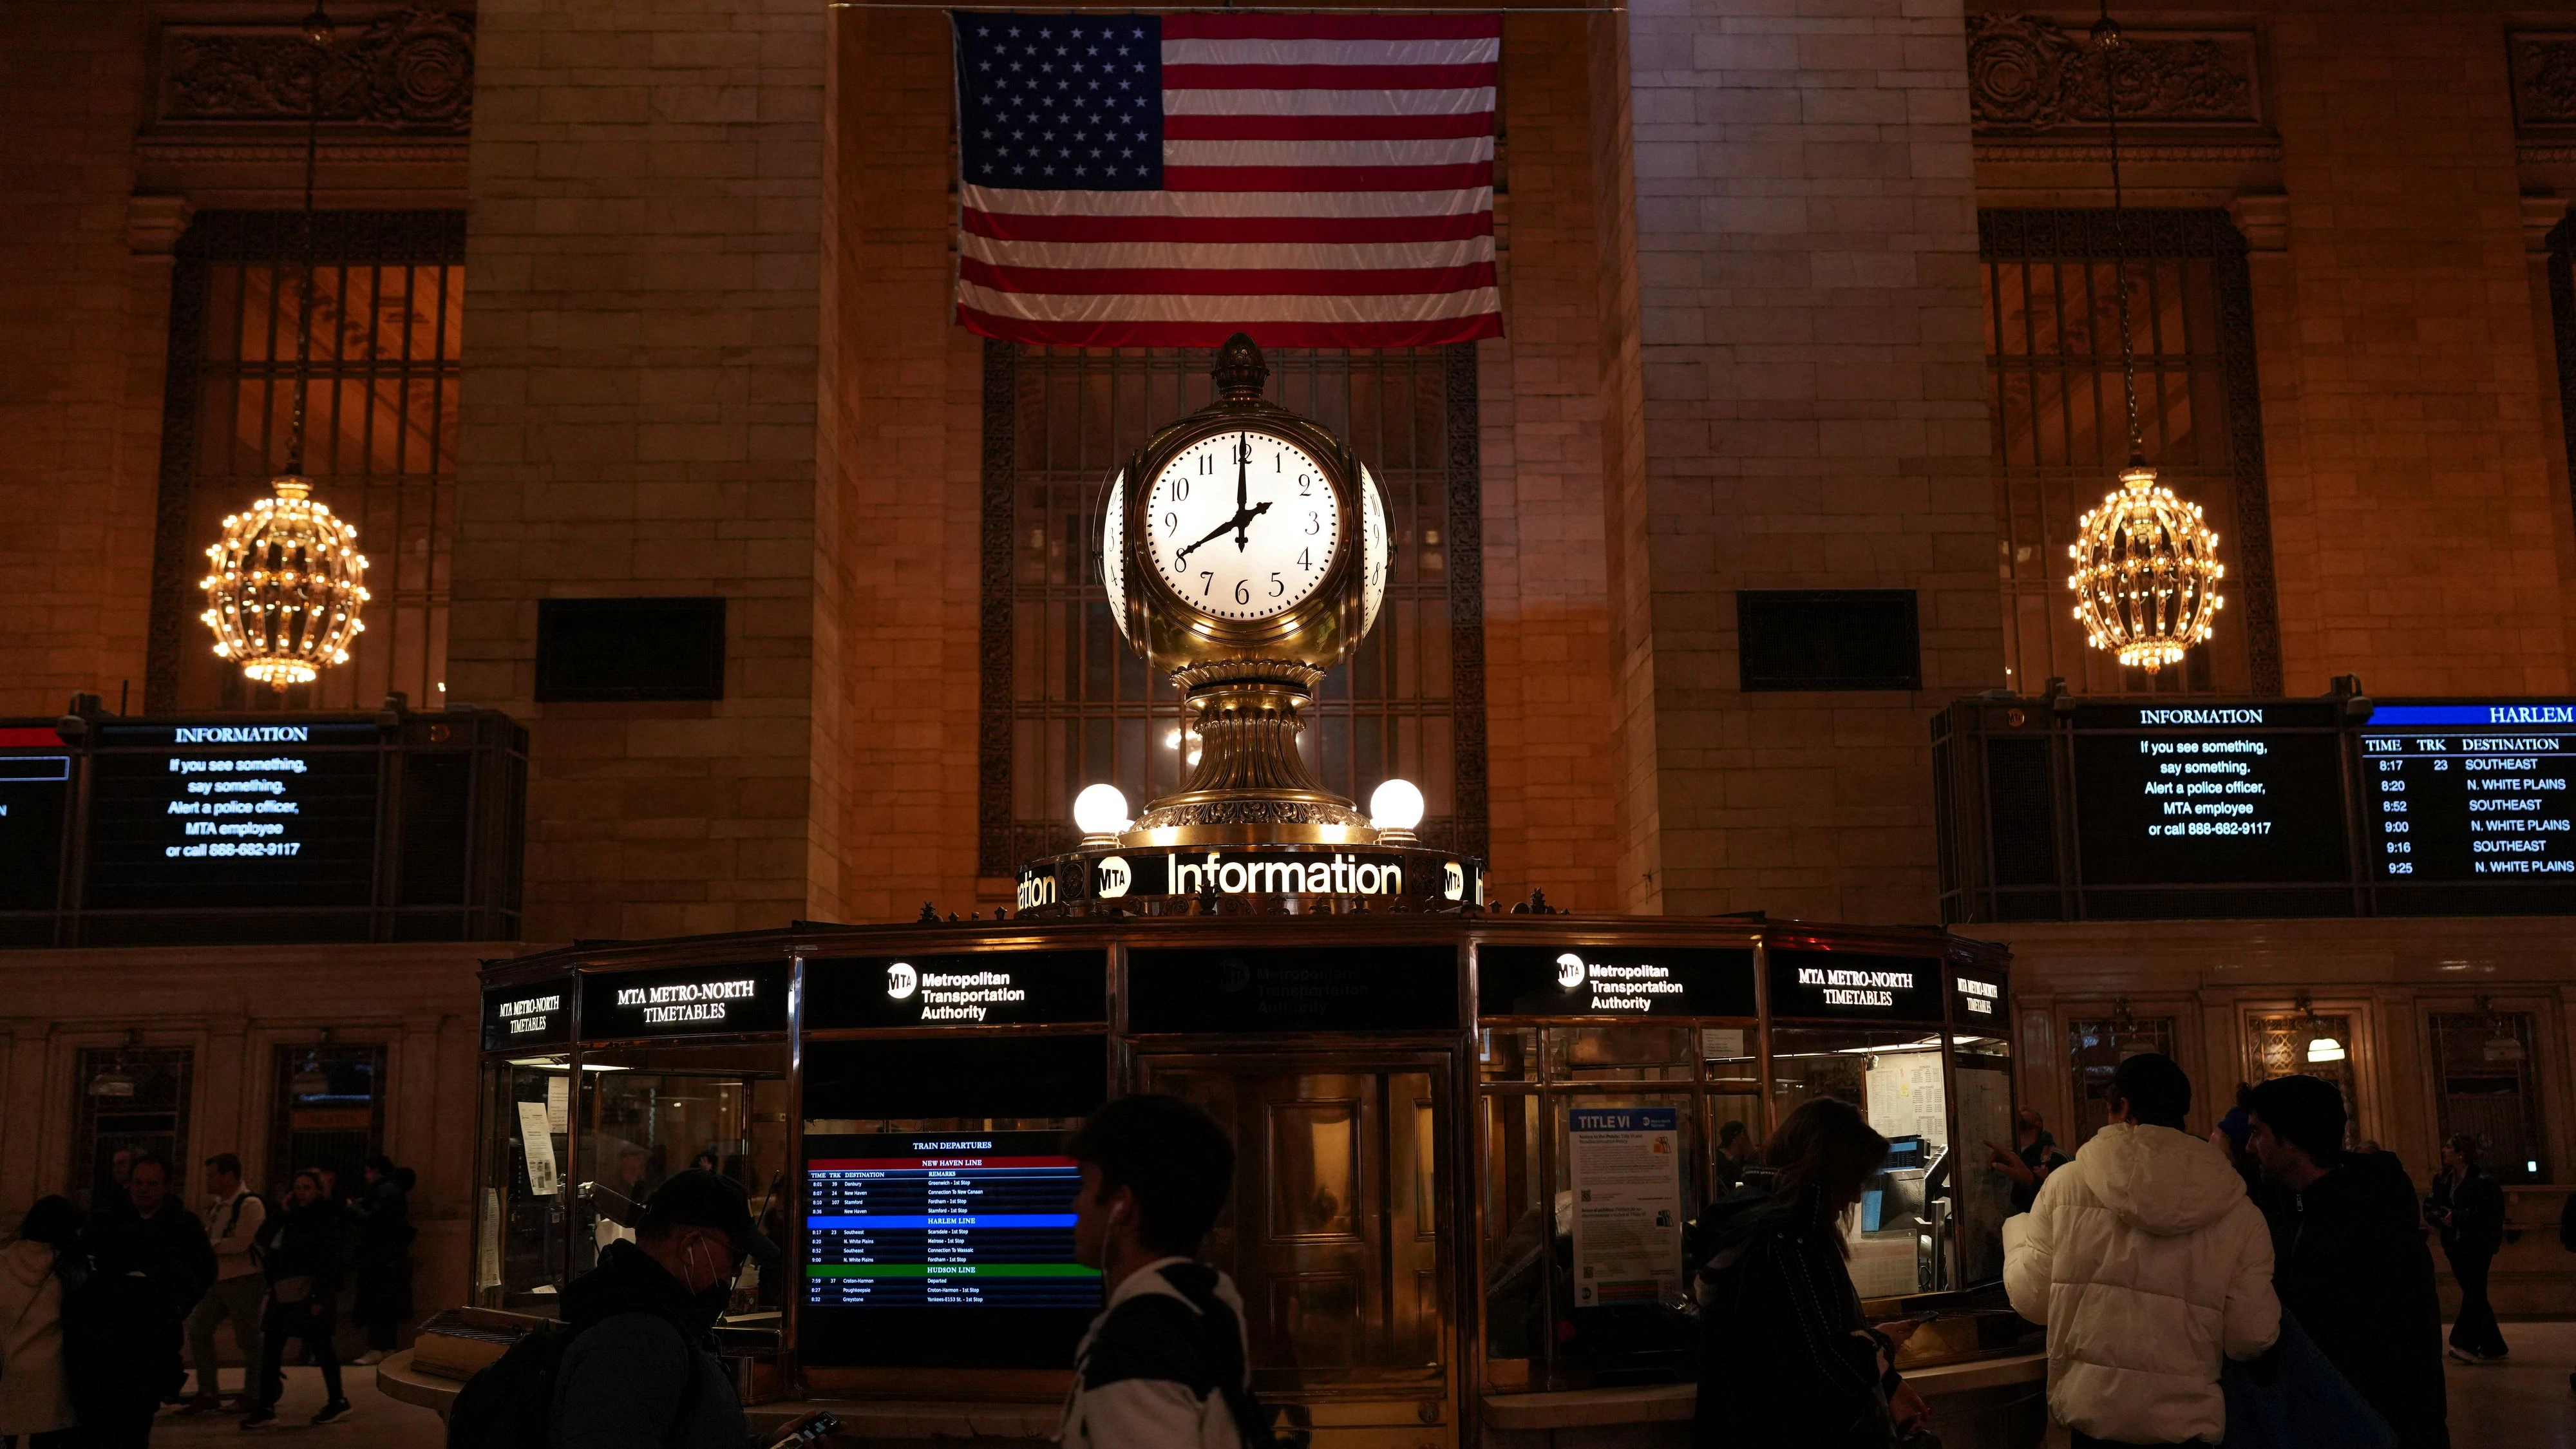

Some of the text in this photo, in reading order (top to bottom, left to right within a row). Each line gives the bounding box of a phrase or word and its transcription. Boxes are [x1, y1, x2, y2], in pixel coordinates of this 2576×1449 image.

[1232, 444, 1253, 465] 12
[1275, 452, 1282, 473] 1
[1198, 453, 1213, 476] 11
[1171, 477, 1189, 502] 10
[1298, 474, 1312, 497] 2
[1165, 512, 1178, 538] 9
[1304, 511, 1320, 535] 3
[1174, 547, 1188, 573] 8
[1297, 547, 1312, 571] 4
[1200, 571, 1214, 596] 7
[1268, 572, 1284, 598] 5
[1235, 580, 1249, 605] 6
[2141, 710, 2262, 724] INFORMATION
[2490, 707, 2573, 723] HARLEM
[176, 727, 307, 743] INFORMATION
[2141, 740, 2267, 755] If you see something,
[2365, 739, 2559, 751] TIME TRK DESTINATION
[170, 758, 307, 774] If you see something,
[2161, 761, 2250, 776] say something.
[2380, 759, 2537, 771] 8:17 23 SOUTHEAST
[188, 779, 285, 795] say something.
[2145, 781, 2265, 796] Alert a police officer,
[2382, 779, 2566, 791] 8:20 N. WHITE PLAINS
[167, 800, 298, 816] Alert a police officer,
[2164, 802, 2253, 817] MTA employee
[2383, 799, 2542, 811] 8:52 SOUTHEAST
[185, 822, 283, 837] MTA employee
[2149, 822, 2271, 835] or call 888-682-9117
[2385, 820, 2570, 832] 9:00 N. WHITE PLAINS
[166, 847, 181, 857] or
[183, 844, 207, 857] call
[2387, 840, 2546, 853] 9:16 SOUTHEAST
[1168, 853, 1401, 895] Information
[2389, 861, 2574, 873] 9:25 N. WHITE PLAINS
[1589, 964, 1669, 980] Metropolitan
[1799, 969, 1913, 987] MTA METRO-NORTH
[922, 972, 1010, 989] Metropolitan
[1590, 981, 1683, 995] Transportation
[1957, 978, 1998, 998] MTA METRO-NORTH
[618, 980, 754, 1005] MTA METRO-NORTH
[922, 988, 1024, 1005] Transportation
[1823, 989, 1892, 1005] TIMETABLES
[500, 996, 559, 1017] MTA METRO-NORTH
[1591, 996, 1651, 1011] Authority
[1967, 997, 1991, 1014] TIMETABLES
[643, 1003, 725, 1022] TIMETABLES
[922, 1005, 986, 1021] Authority
[511, 1016, 545, 1033] TIMETABLES
[1578, 1116, 1629, 1128] TITLE VI
